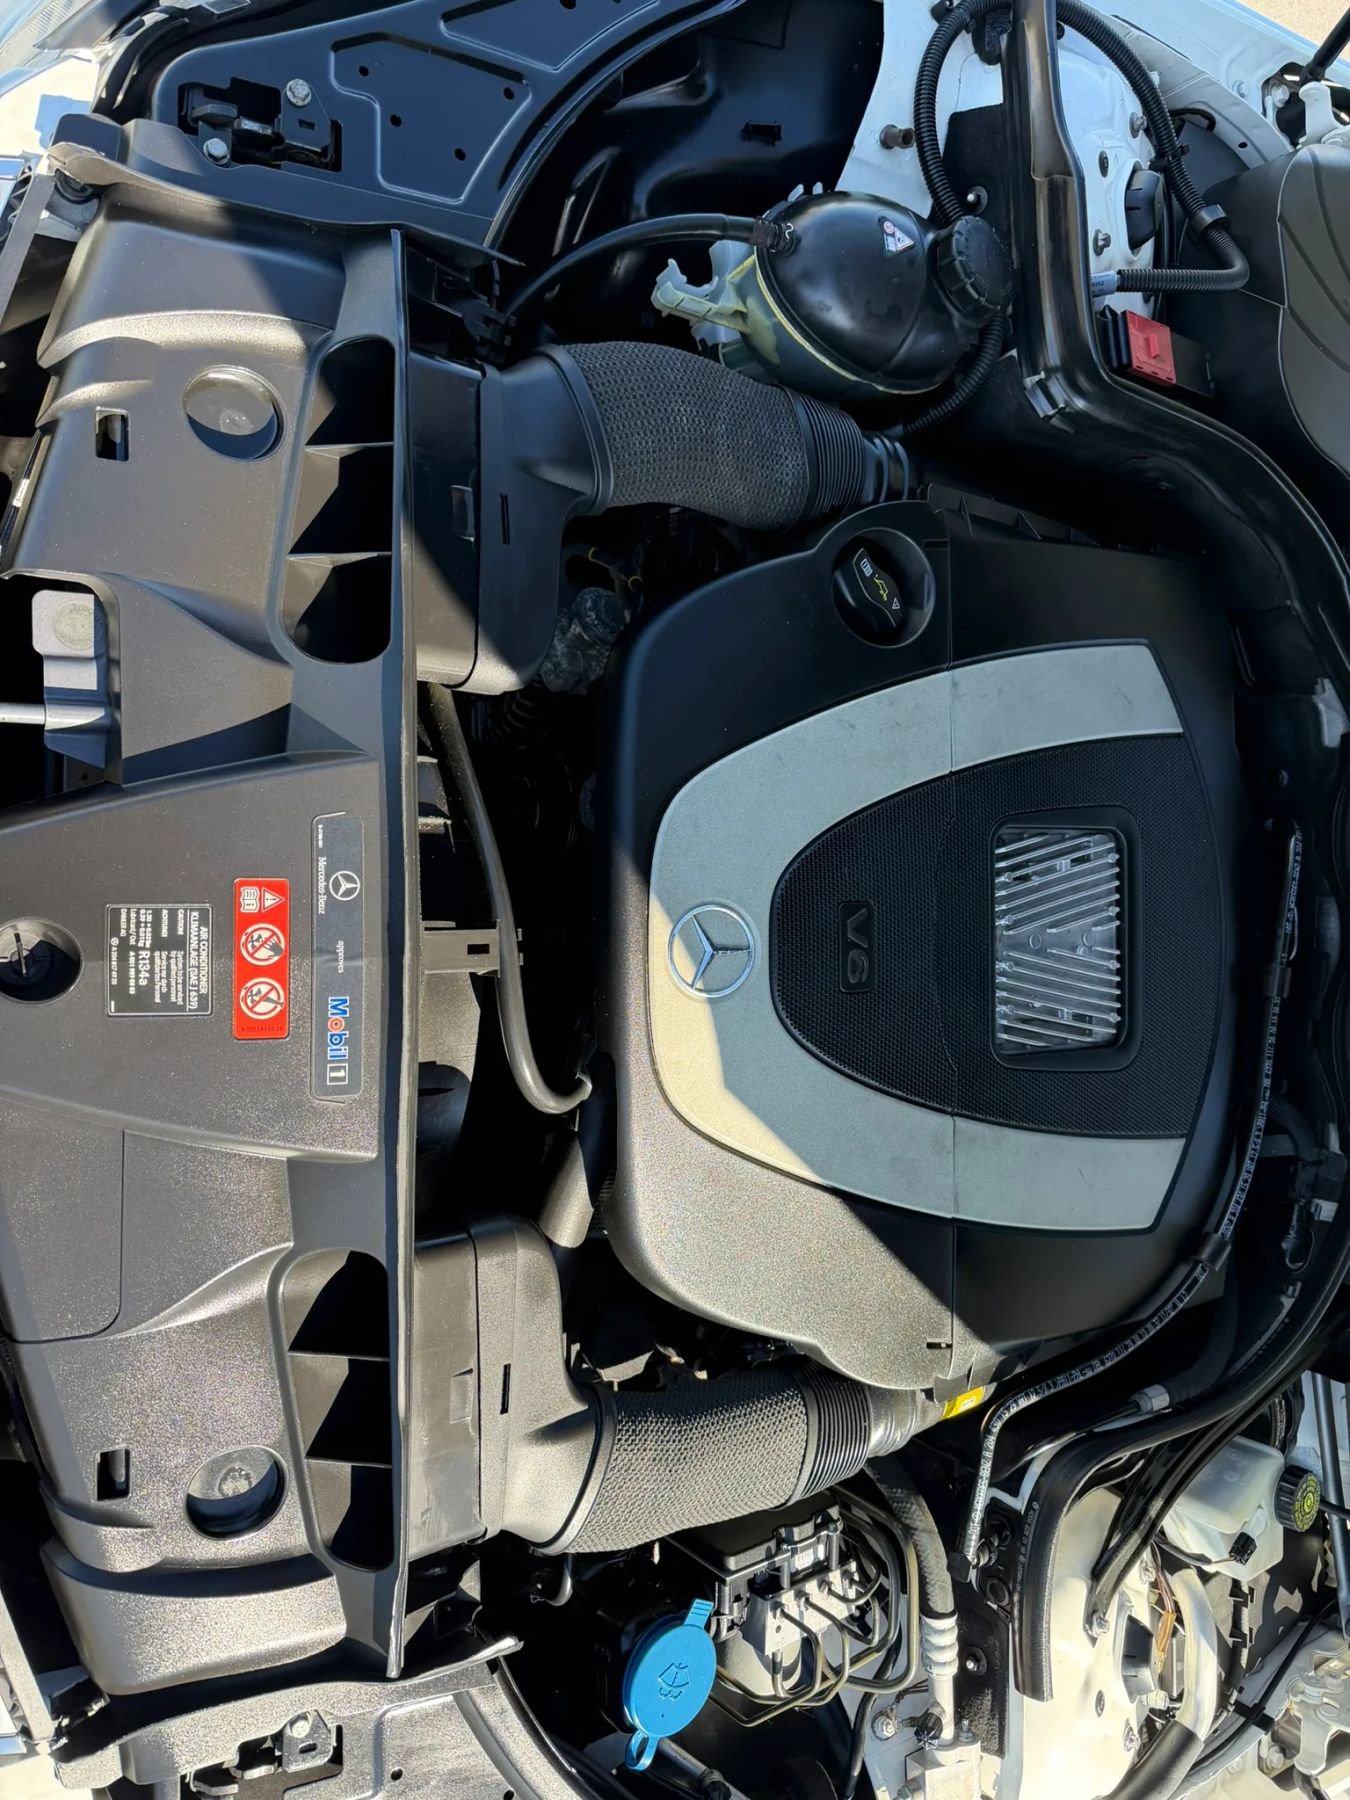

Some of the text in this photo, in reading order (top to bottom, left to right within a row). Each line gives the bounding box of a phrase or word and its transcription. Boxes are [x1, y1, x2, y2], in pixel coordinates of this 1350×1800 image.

[318, 857, 327, 914] Mercedes-Benz
[190, 912, 198, 966] KLIMAANLAGE
[336, 940, 345, 973] approves
[847, 907, 870, 984] V6
[138, 950, 150, 986] R134a
[188, 968, 198, 985] (SAE
[199, 941, 208, 993] CONDITIONER
[188, 991, 197, 1009] 639)
[328, 996, 350, 1060] Mobil
